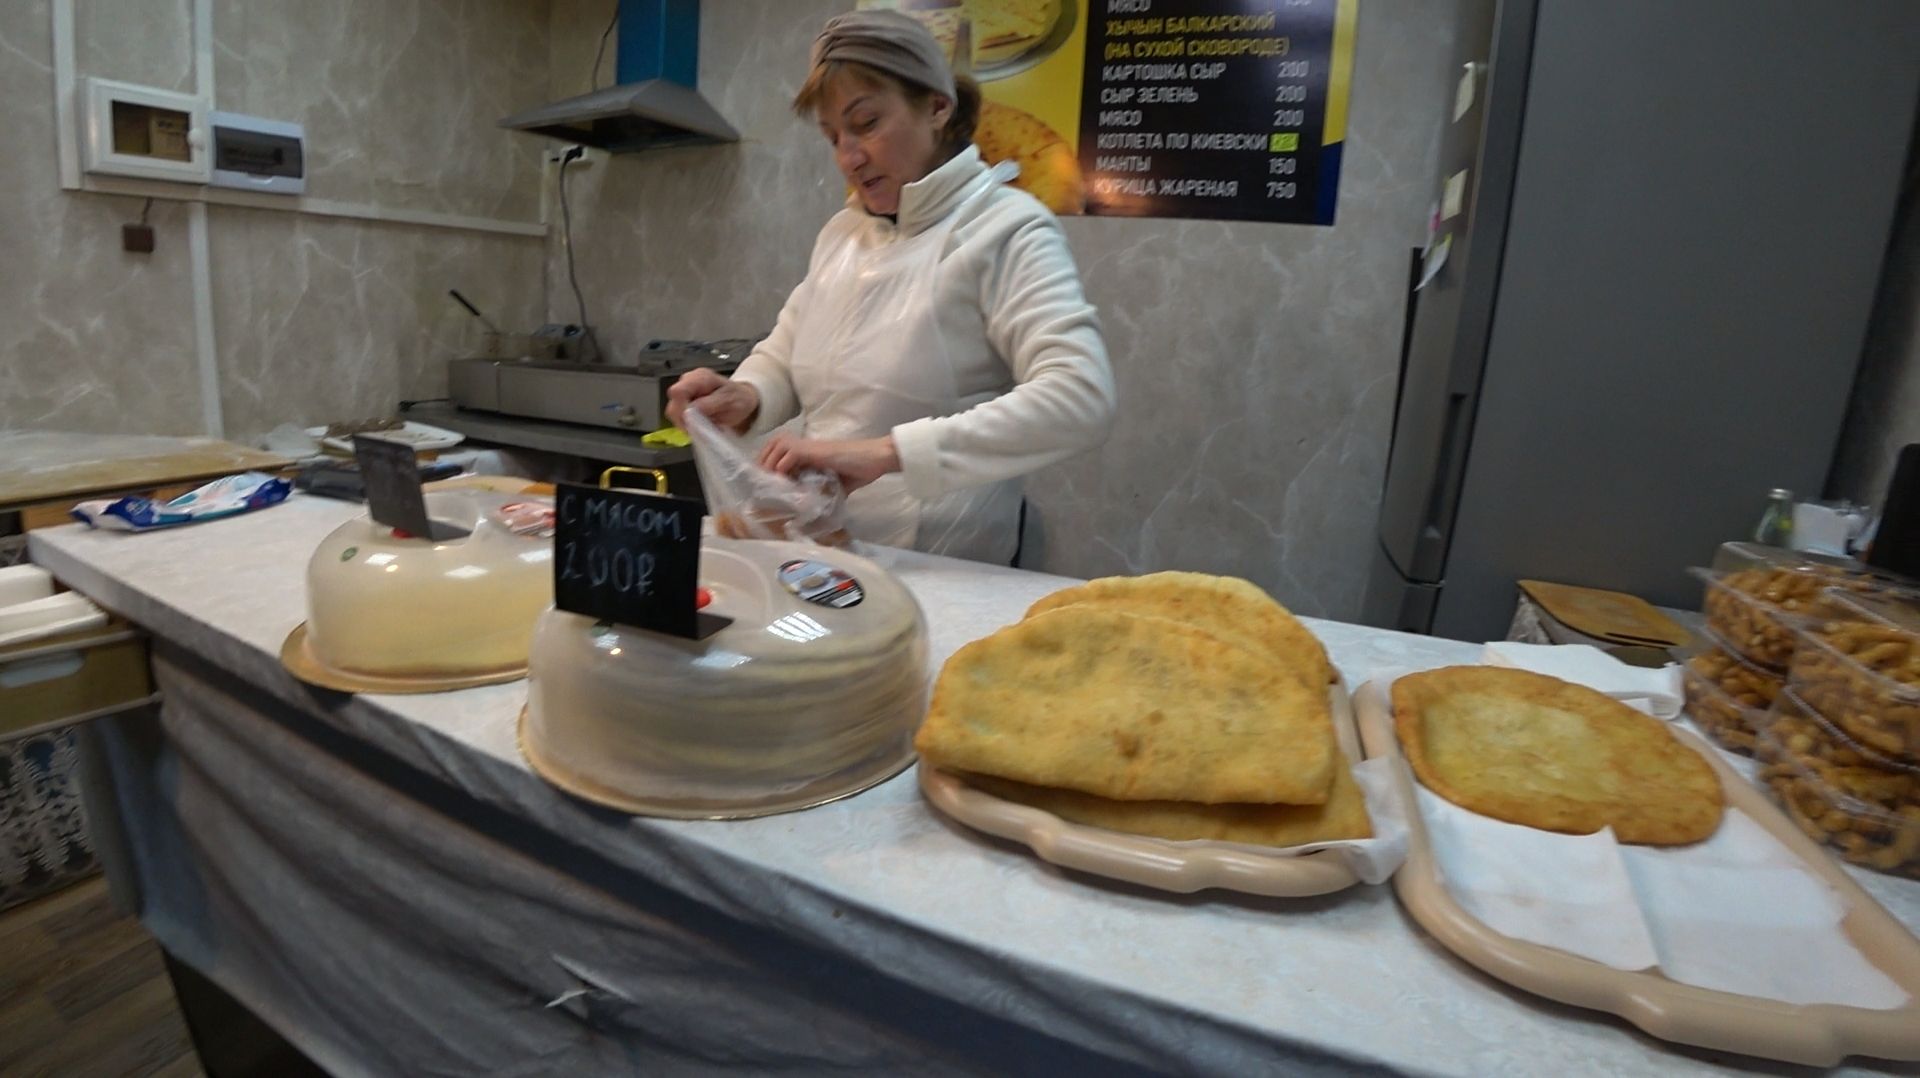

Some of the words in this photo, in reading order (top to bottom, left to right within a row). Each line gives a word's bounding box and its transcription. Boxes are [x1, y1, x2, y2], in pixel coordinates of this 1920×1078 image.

[1106, 19, 1163, 35] ХЫЧЫН
[1165, 12, 1276, 34] БАЛКАРСКИЙ
[1134, 38, 1185, 56] СУХОЙ
[1102, 63, 1188, 81] КАРТОШКА
[1190, 62, 1227, 79] СЫР
[1277, 61, 1309, 78] 200
[1100, 88, 1135, 104] СЫР
[1137, 86, 1199, 103] ЗЕЛЕНЬ
[1275, 86, 1307, 102] 200
[1099, 110, 1143, 126] МЯСО
[1273, 110, 1304, 126] 200
[1097, 134, 1163, 150] КОТЛЕТА
[1166, 134, 1188, 149] ПО
[1191, 134, 1268, 150] КИЕВСКИ
[1096, 156, 1151, 172] МАНТЫ
[1268, 158, 1296, 175] 150
[1094, 179, 1157, 196] КУРИЦА
[1159, 179, 1238, 197] ЖАРЕНАЯ
[1266, 182, 1296, 198] 750
